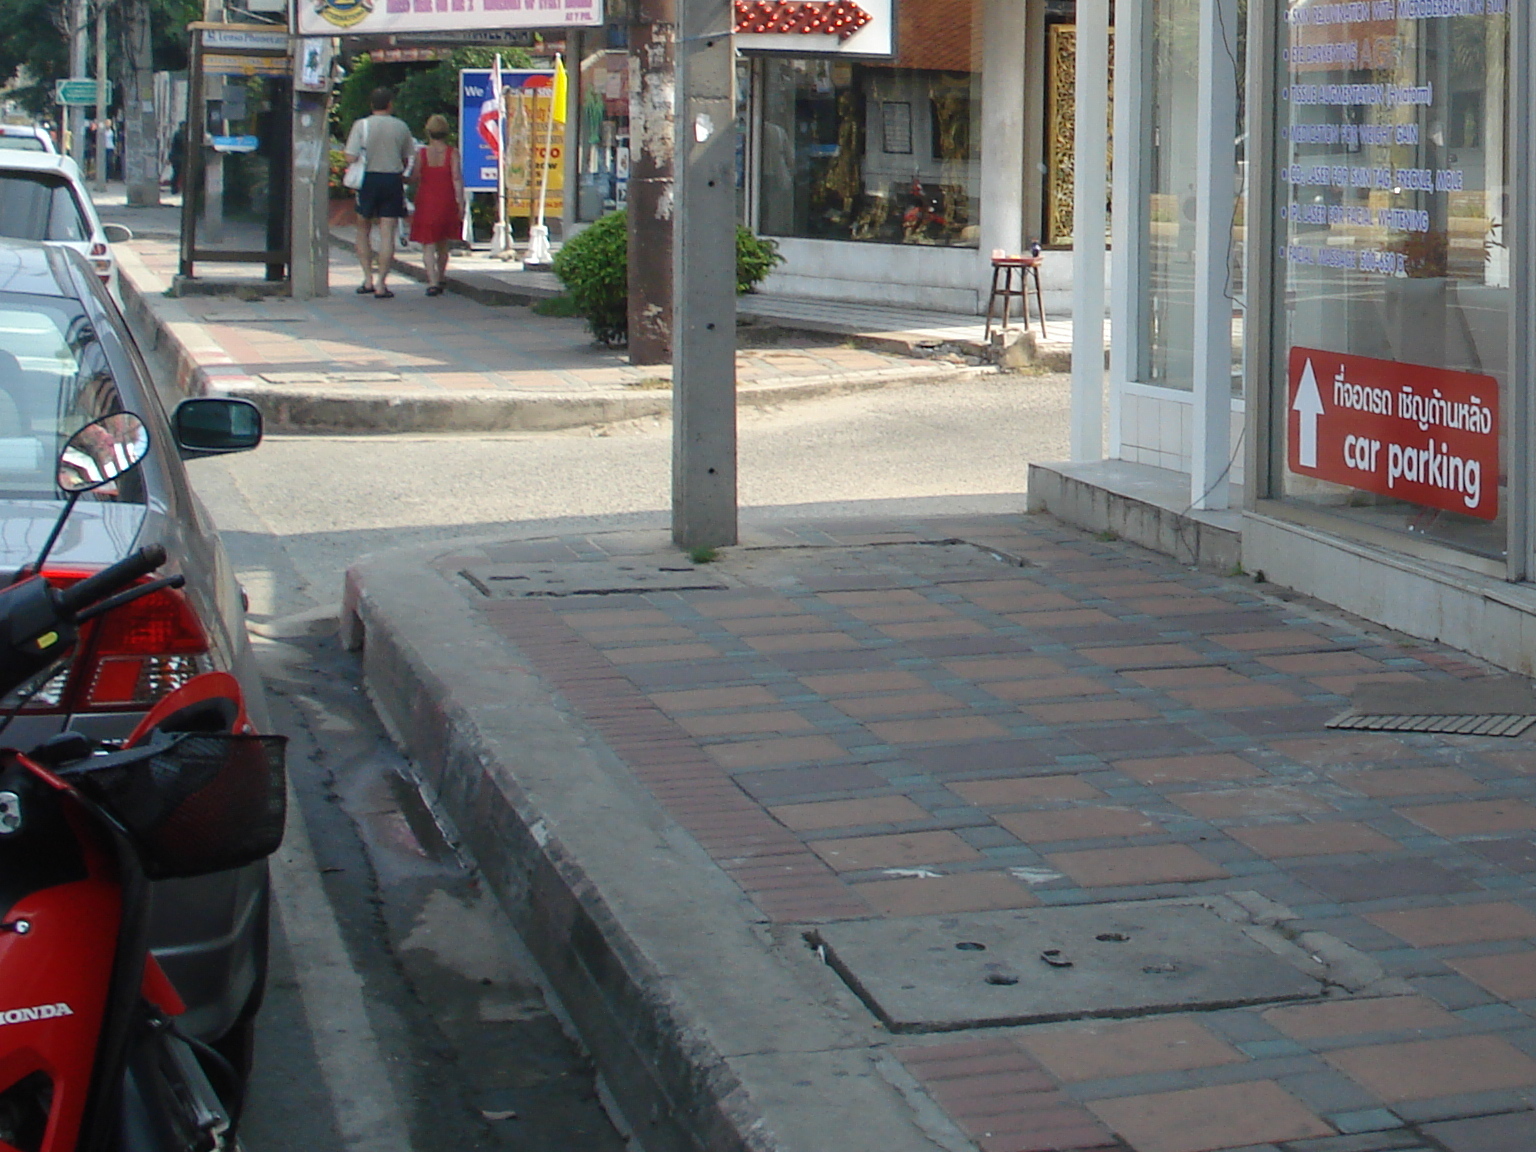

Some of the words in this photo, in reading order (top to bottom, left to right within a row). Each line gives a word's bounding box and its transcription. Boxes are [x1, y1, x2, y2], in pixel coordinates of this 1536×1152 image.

[464, 86, 484, 97] We
[1333, 363, 1393, 417] ที่จอดรถ
[1398, 385, 1492, 435] เชิญด้านหลัง
[1343, 434, 1381, 474] car
[1388, 438, 1481, 510] parking
